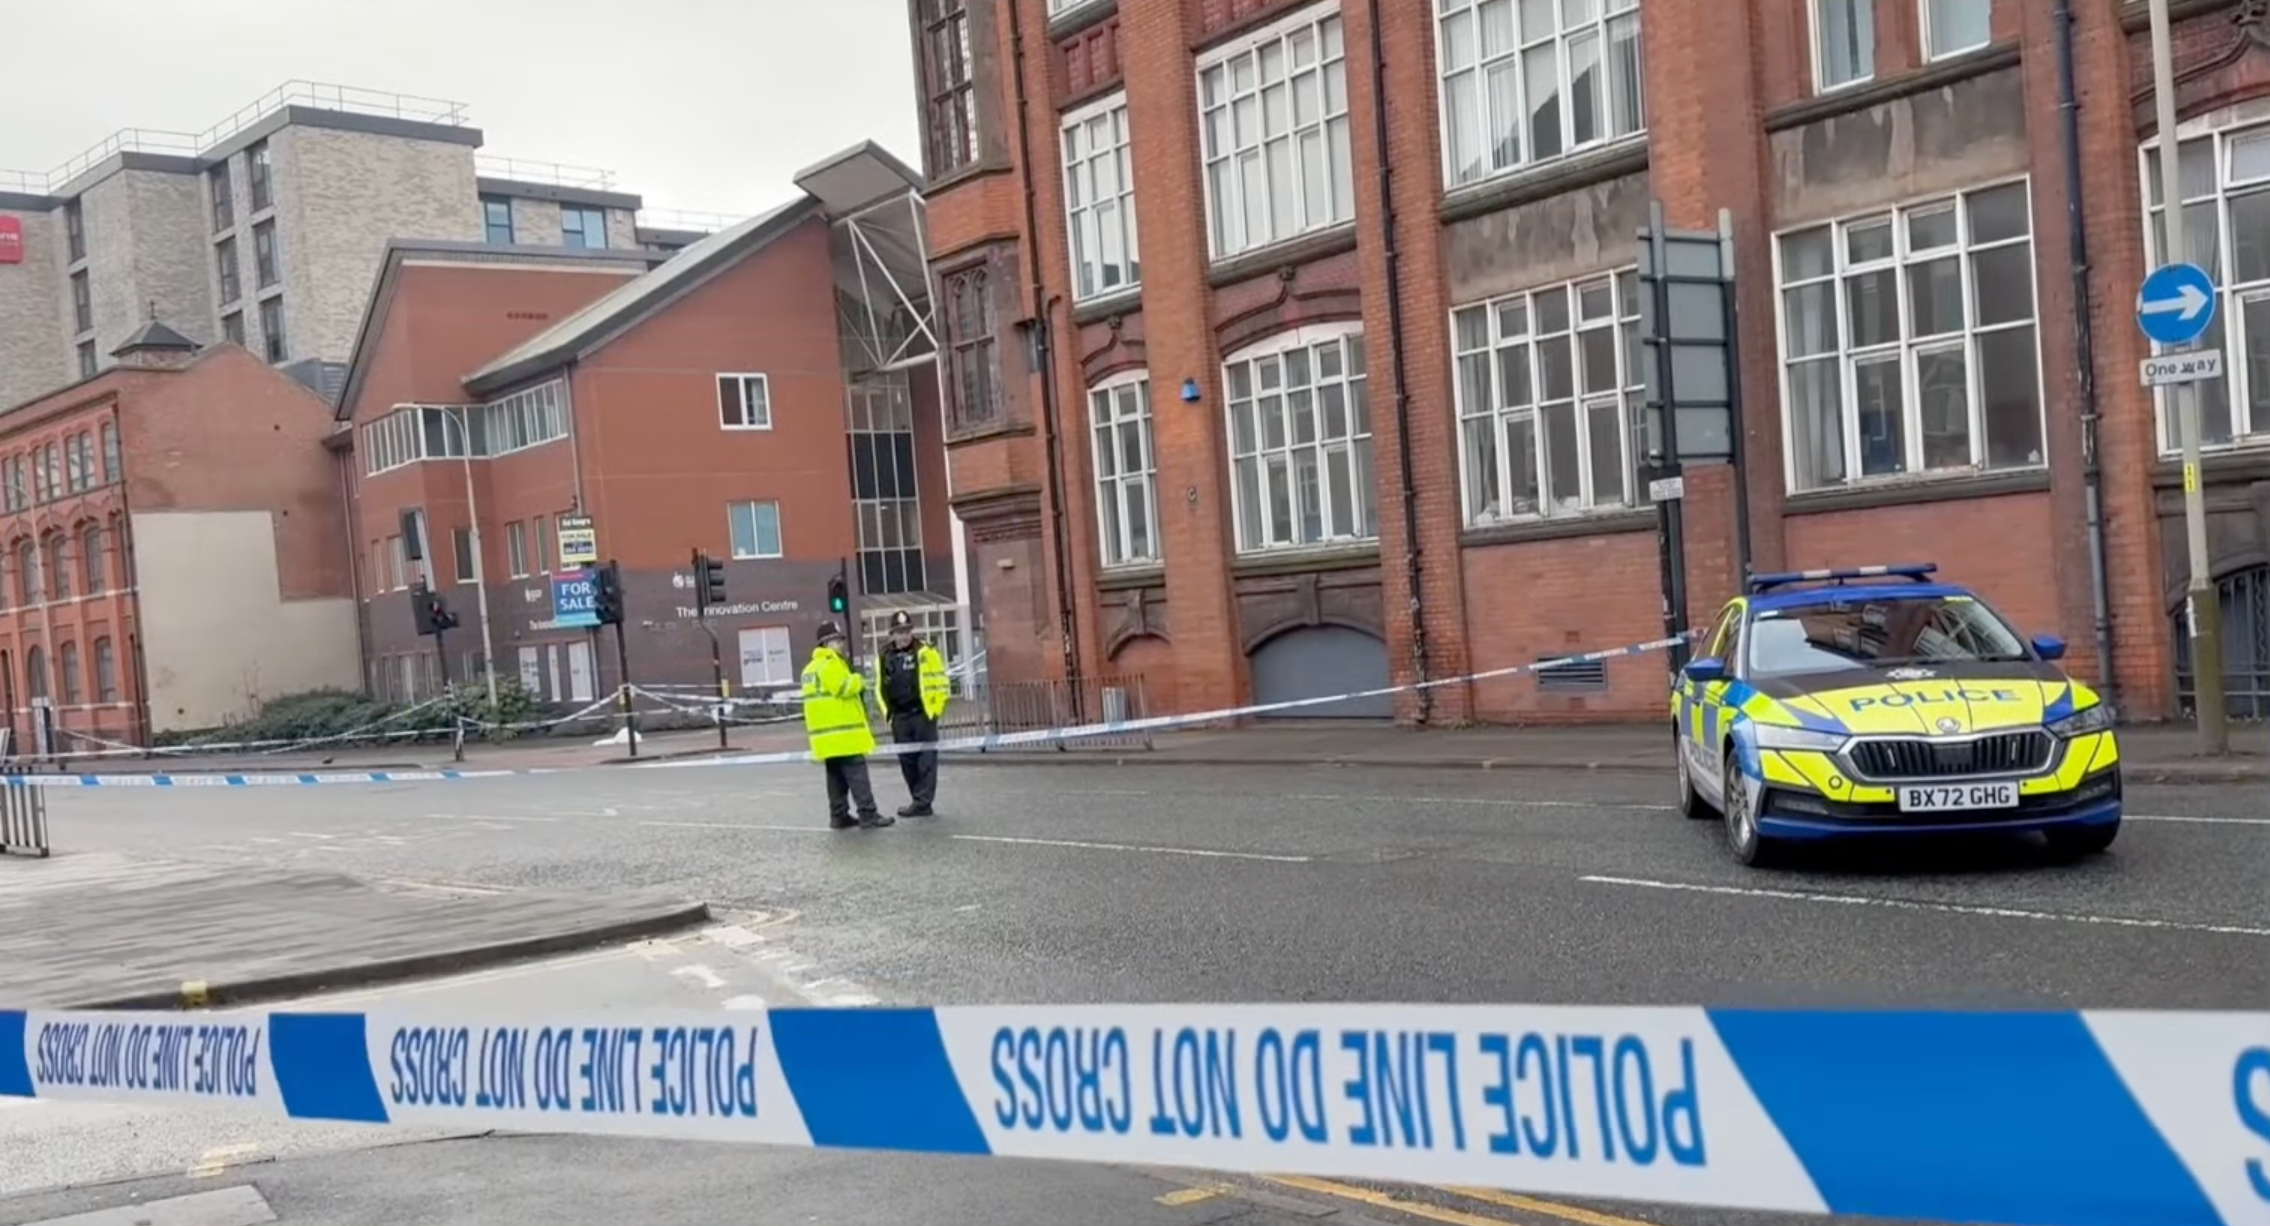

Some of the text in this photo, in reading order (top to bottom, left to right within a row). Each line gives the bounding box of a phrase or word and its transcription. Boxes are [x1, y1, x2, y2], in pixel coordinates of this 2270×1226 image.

[2145, 359, 2216, 377] One way
[561, 581, 591, 596] FOR
[560, 596, 595, 611] SALE
[675, 600, 798, 618] The nnovation Centre
[1850, 690, 2022, 711] POLICE
[1909, 786, 2010, 808] BX72 GHG
[37, 1022, 261, 1096] POLICE LINE DO NOT CROSS
[390, 1026, 758, 1118] POLICE LINE DO NOT CROSS
[991, 1026, 1707, 1168] POLICE LINE DO NOT CROSS
